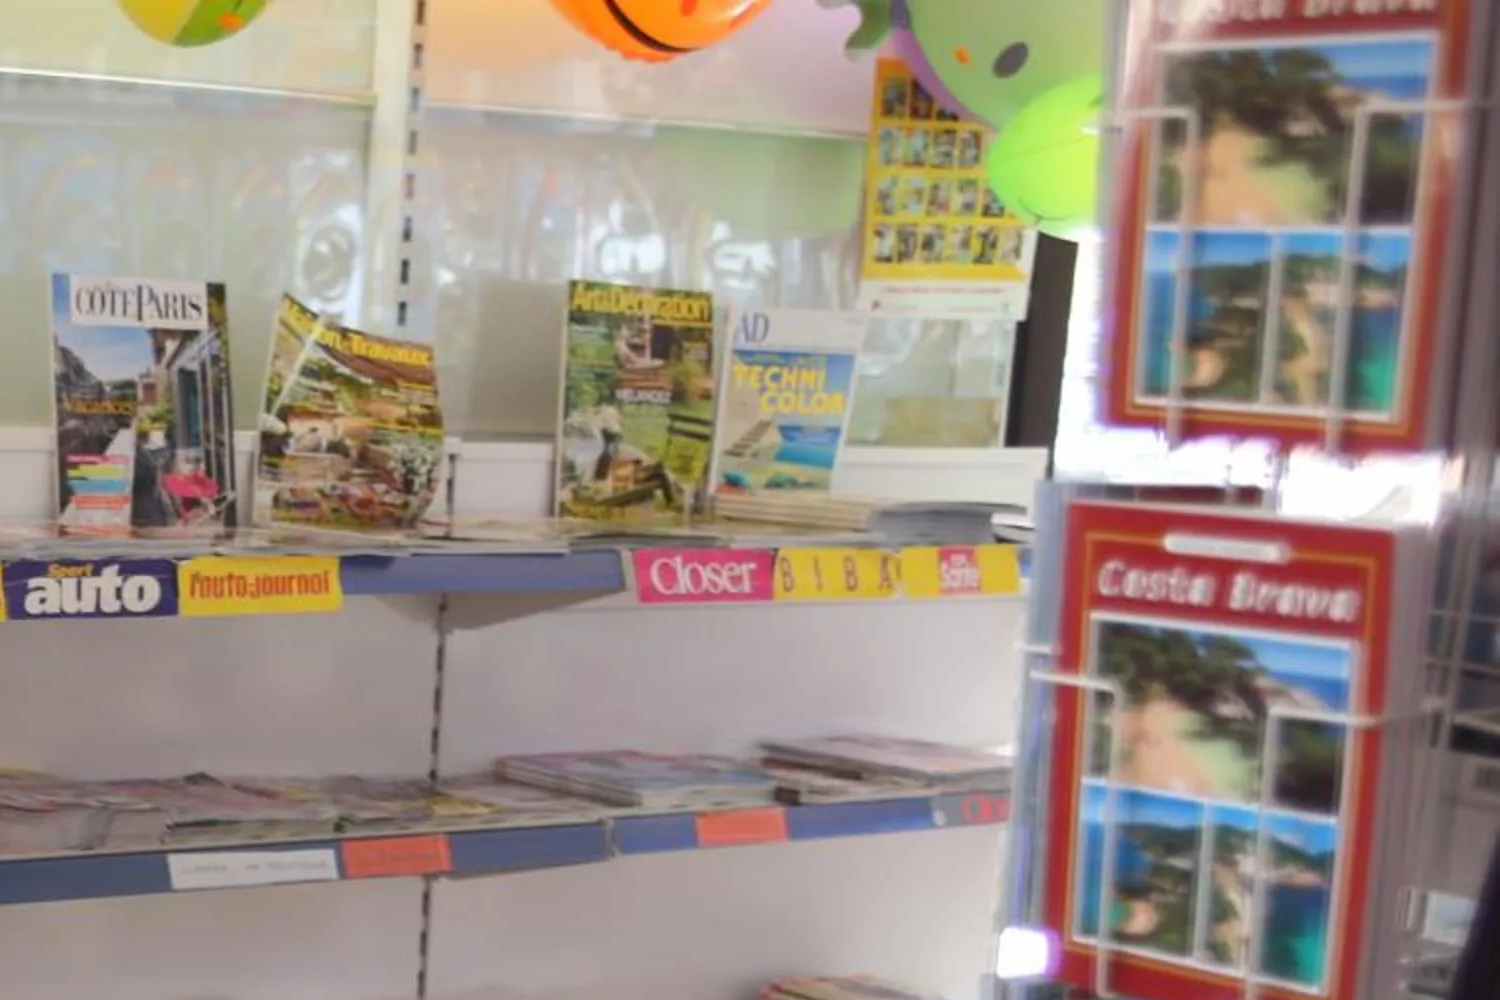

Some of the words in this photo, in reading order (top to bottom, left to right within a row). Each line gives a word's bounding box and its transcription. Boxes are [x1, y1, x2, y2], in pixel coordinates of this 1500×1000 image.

[737, 312, 770, 343] AD
[761, 392, 845, 416] COLOR
[25, 573, 161, 617] auto
[650, 555, 758, 596] Closer
[1097, 559, 1216, 607] Costa
[1228, 572, 1361, 623] Brava
